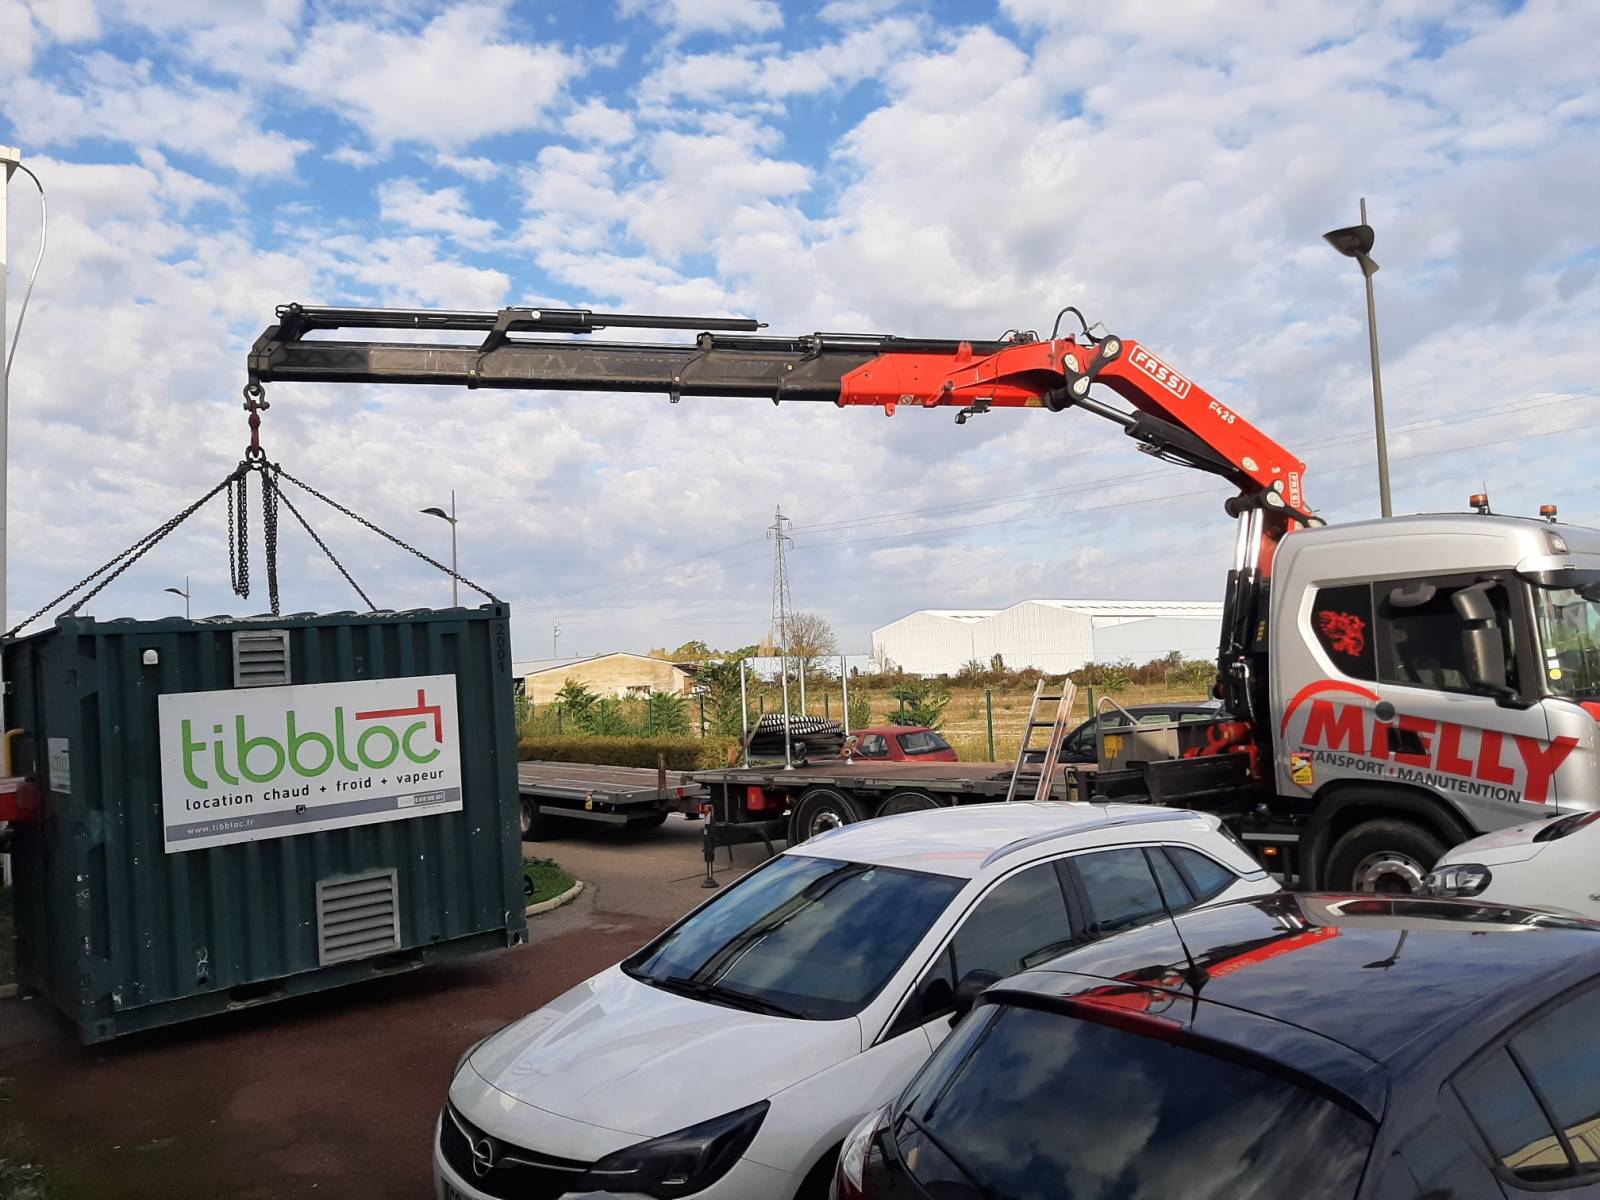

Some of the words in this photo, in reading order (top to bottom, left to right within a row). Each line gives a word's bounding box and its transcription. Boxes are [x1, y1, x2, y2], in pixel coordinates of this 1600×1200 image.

[1135, 351, 1185, 393] FASSI
[1209, 401, 1236, 424] F425
[181, 706, 441, 790] tibbloc
[186, 794, 253, 811] location
[263, 784, 310, 801] chaud
[336, 776, 372, 792] froid
[396, 770, 445, 785] vapeur
[1398, 767, 1521, 804] MANUTENTION
[186, 819, 255, 835] www.tibbloc.fr
